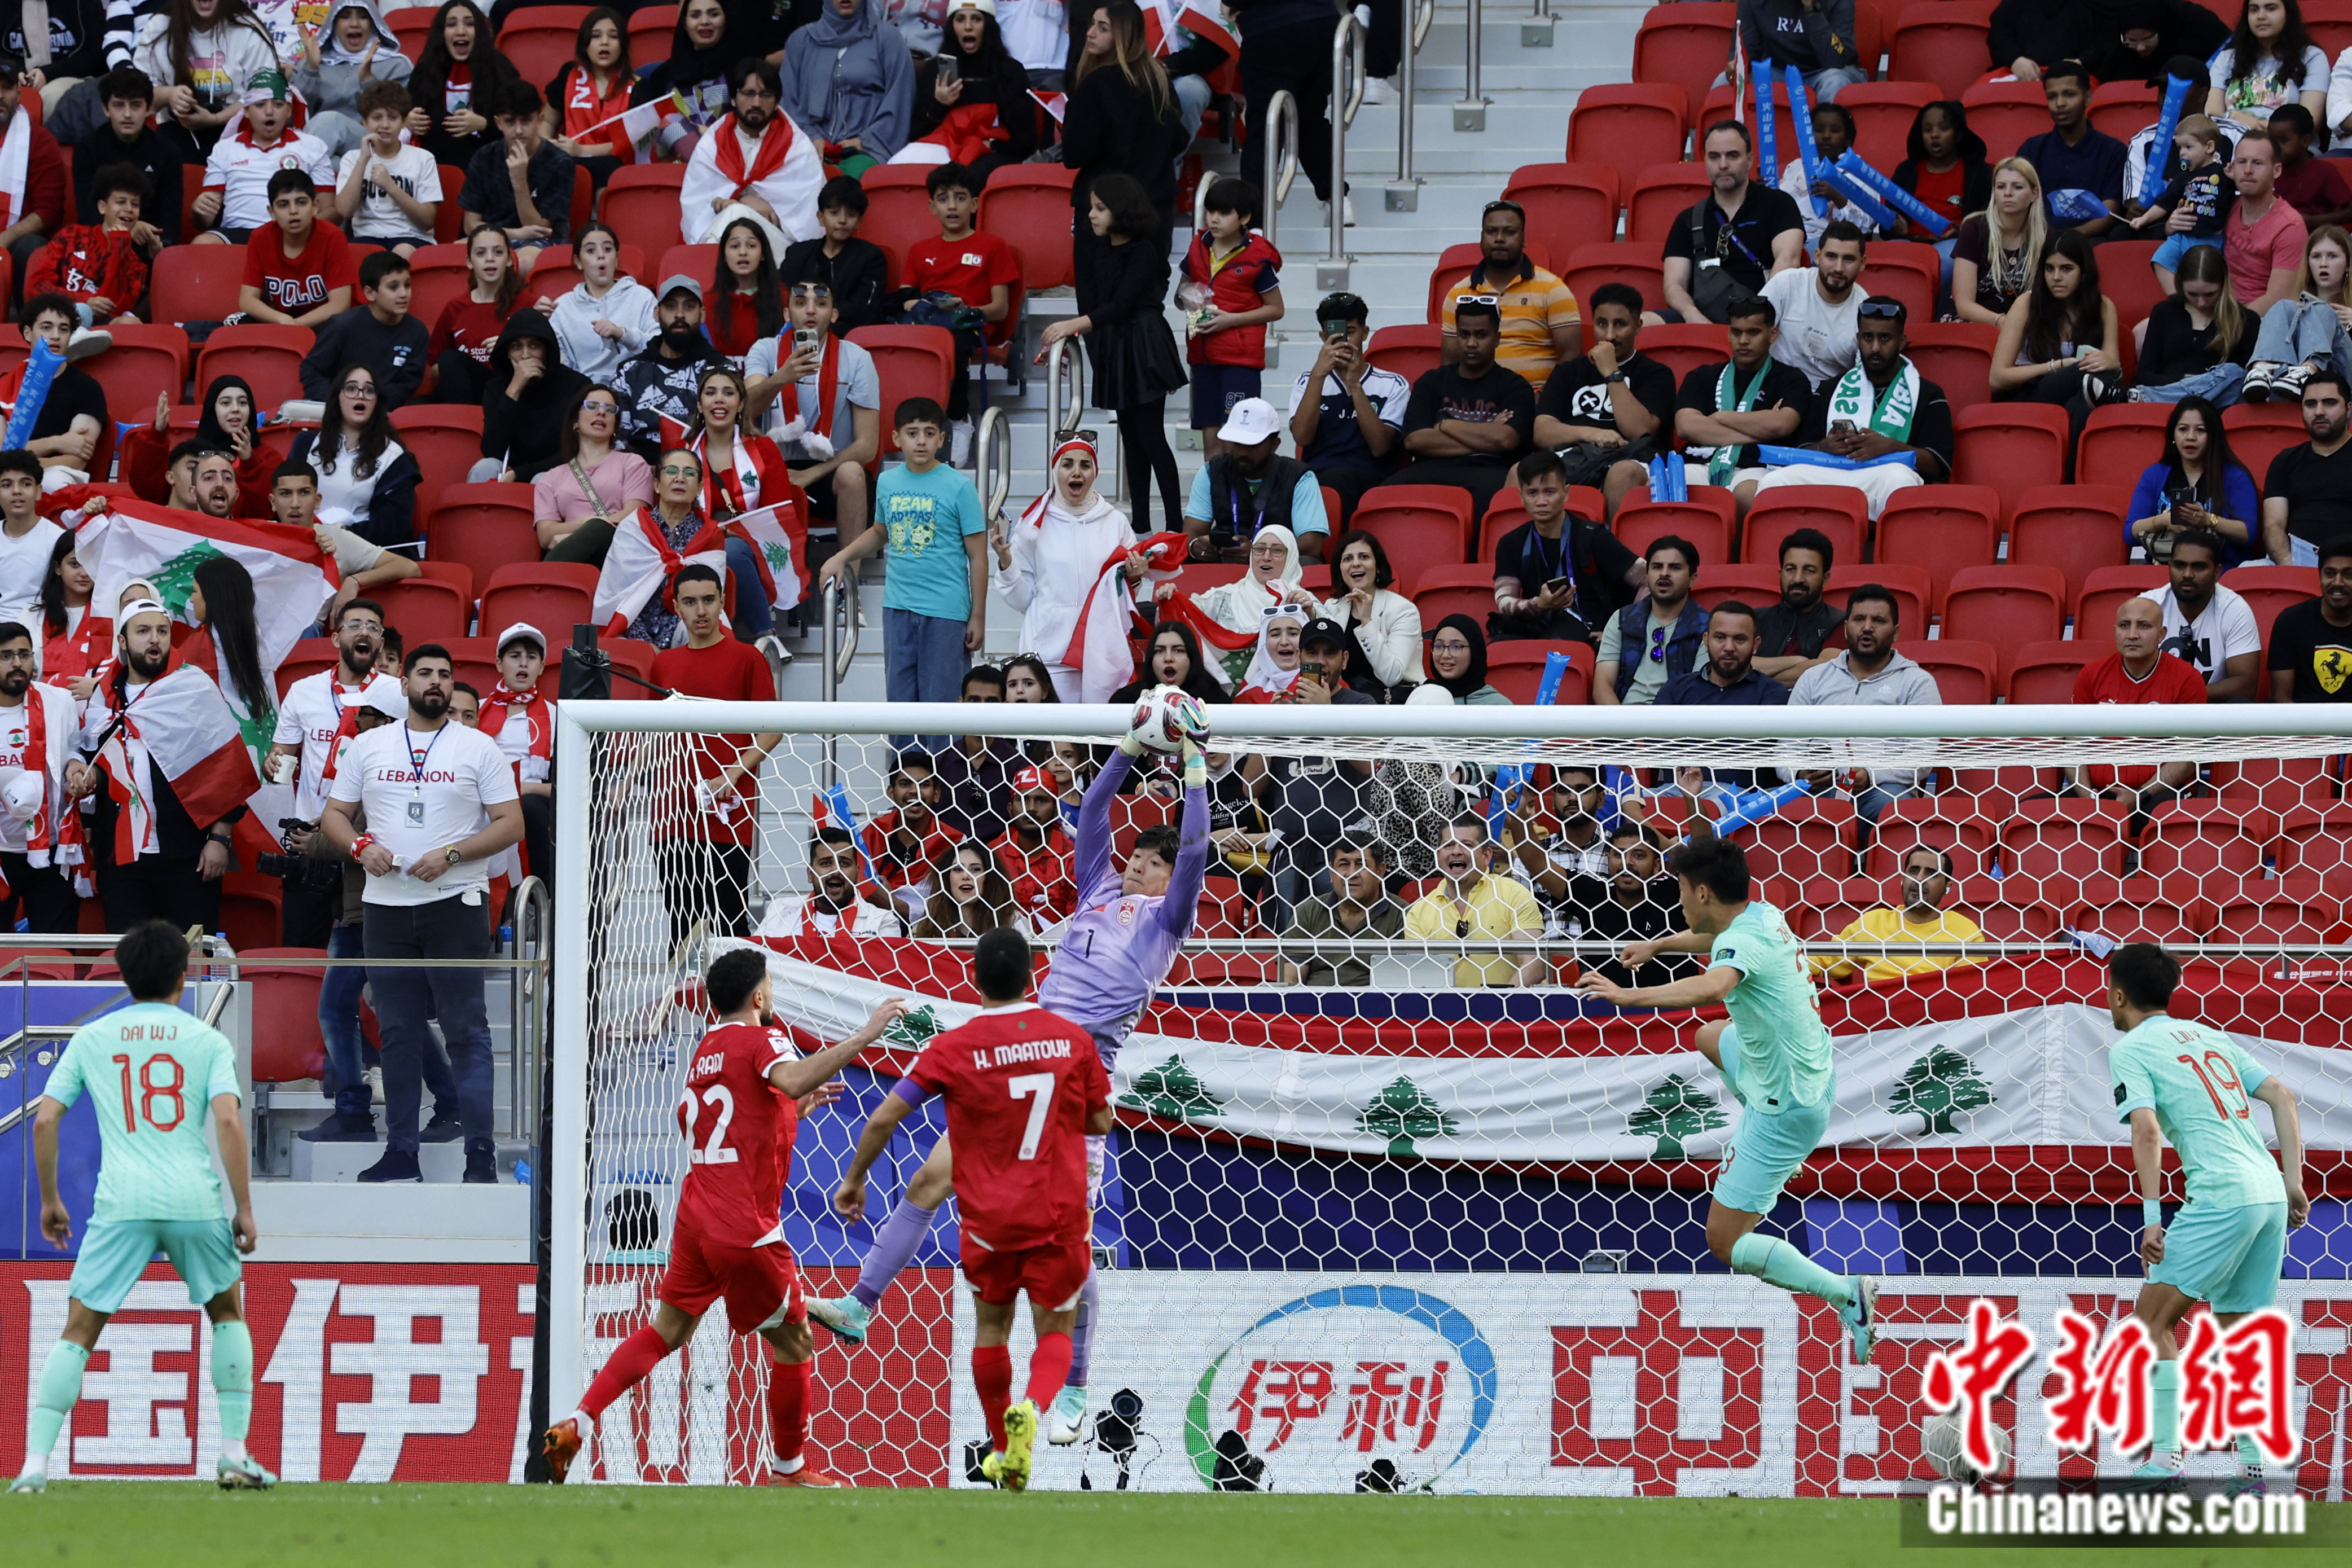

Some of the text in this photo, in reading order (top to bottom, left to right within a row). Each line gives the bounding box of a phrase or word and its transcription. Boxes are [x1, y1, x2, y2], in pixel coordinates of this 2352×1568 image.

[9, 30, 77, 50] CARNIA
[264, 274, 328, 308] POLO
[890, 497, 934, 512] TEAM
[377, 770, 455, 784] LEBANON
[1086, 928, 1094, 959] 1
[121, 1025, 144, 1042] DAI
[973, 1039, 1072, 1070] H. MAATOUK
[112, 1053, 185, 1133] 18
[2177, 1050, 2249, 1121] 19
[678, 1084, 739, 1165] 22
[1008, 1071, 1055, 1161] 7
[1227, 1360, 1449, 1453] 伊利
